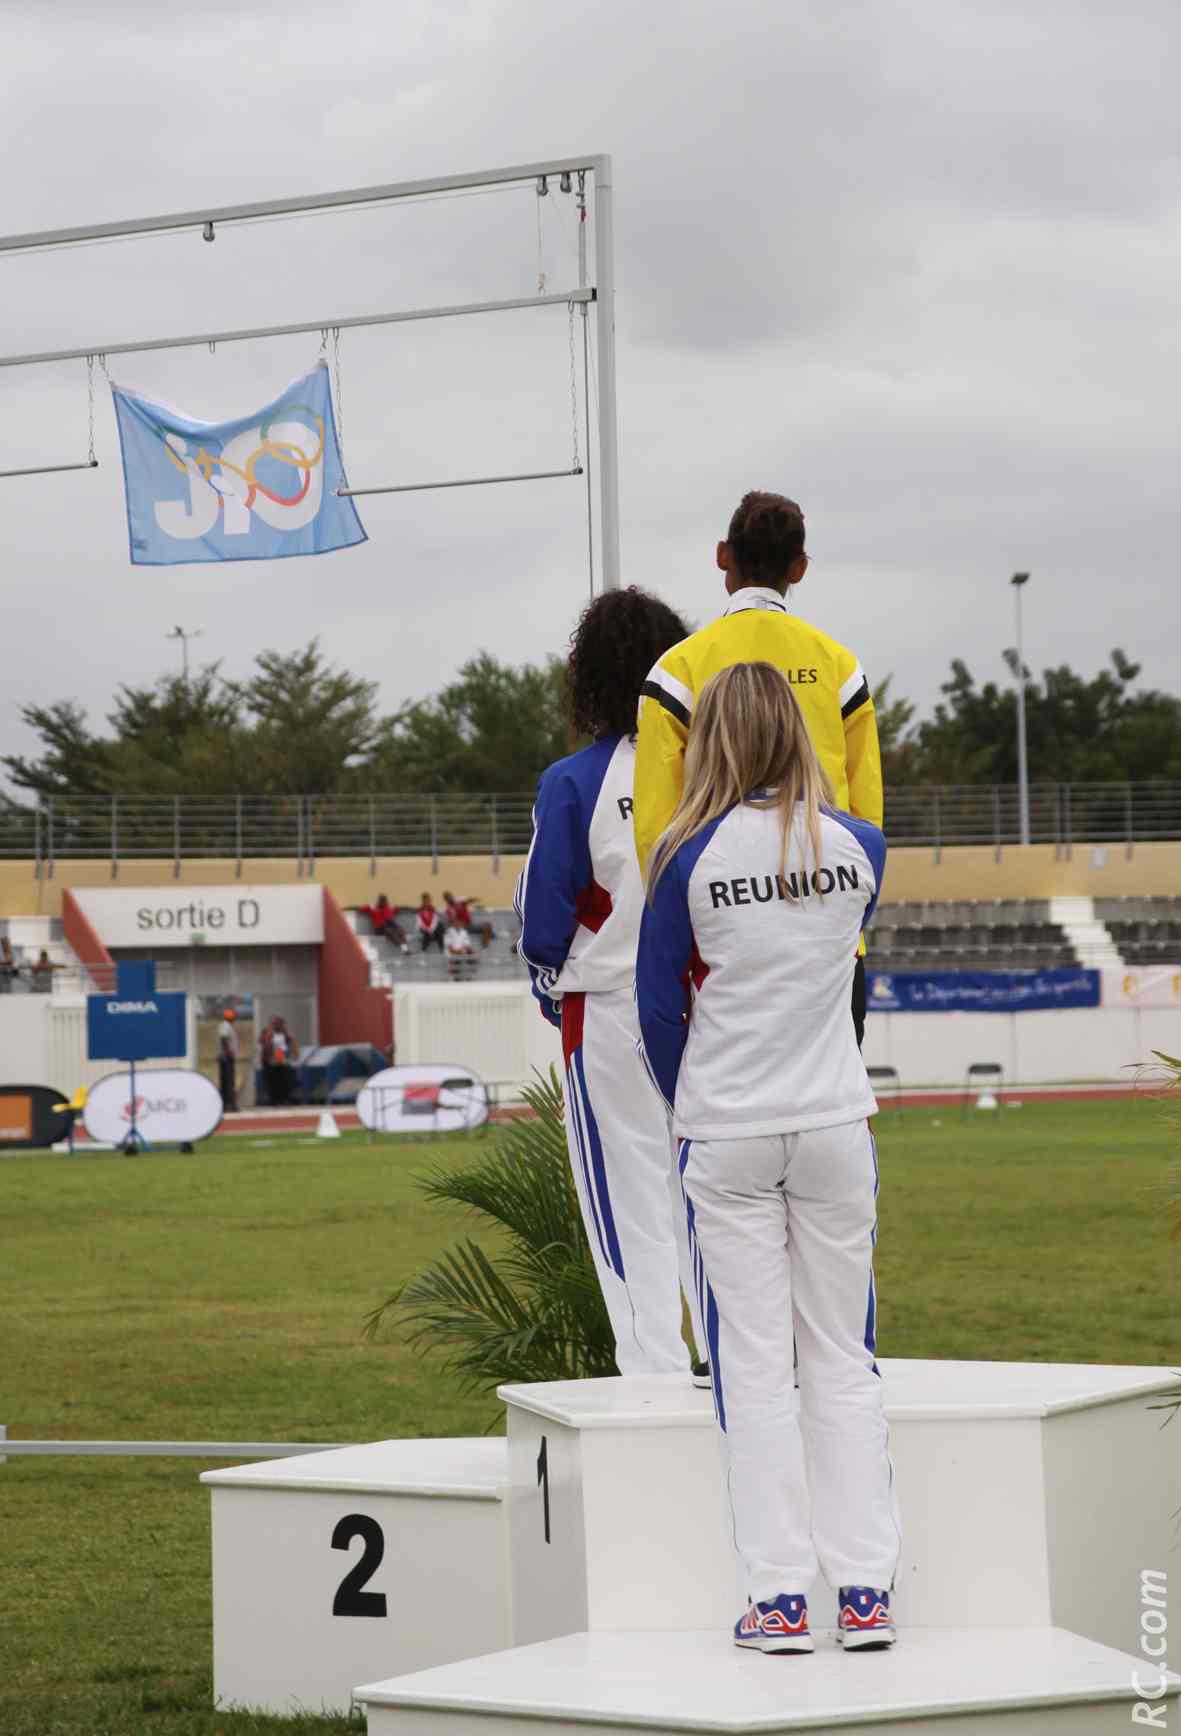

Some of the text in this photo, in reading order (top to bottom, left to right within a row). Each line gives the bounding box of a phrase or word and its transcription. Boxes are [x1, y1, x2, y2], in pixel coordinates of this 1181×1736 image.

[137, 899, 259, 930] sortie D
[709, 864, 860, 909] REUNION
[537, 1435, 550, 1544] 1
[331, 1513, 387, 1617] 2
